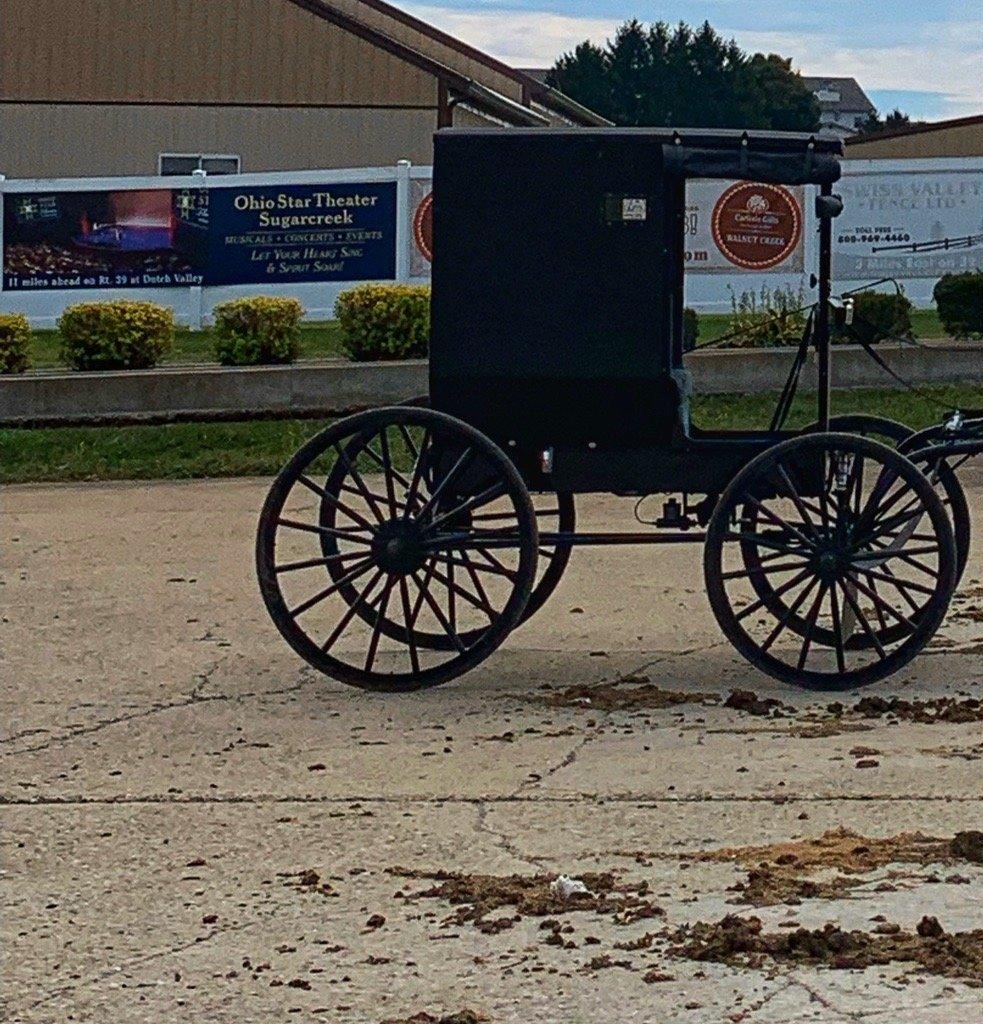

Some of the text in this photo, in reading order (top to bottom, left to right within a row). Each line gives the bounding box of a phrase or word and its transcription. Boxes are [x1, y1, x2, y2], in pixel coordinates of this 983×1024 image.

[234, 192, 378, 210] Ohio Star Theater
[259, 209, 353, 228] Sugarcreek
[225, 230, 382, 245] MUSICALS CONCERTS EVENTS
[726, 234, 785, 246] WALNUT CREEK
[22, 277, 48, 287] miles
[52, 277, 81, 286] ahead
[131, 277, 140, 285] at
[143, 275, 170, 284] Dutch
[174, 274, 203, 285] Valley
